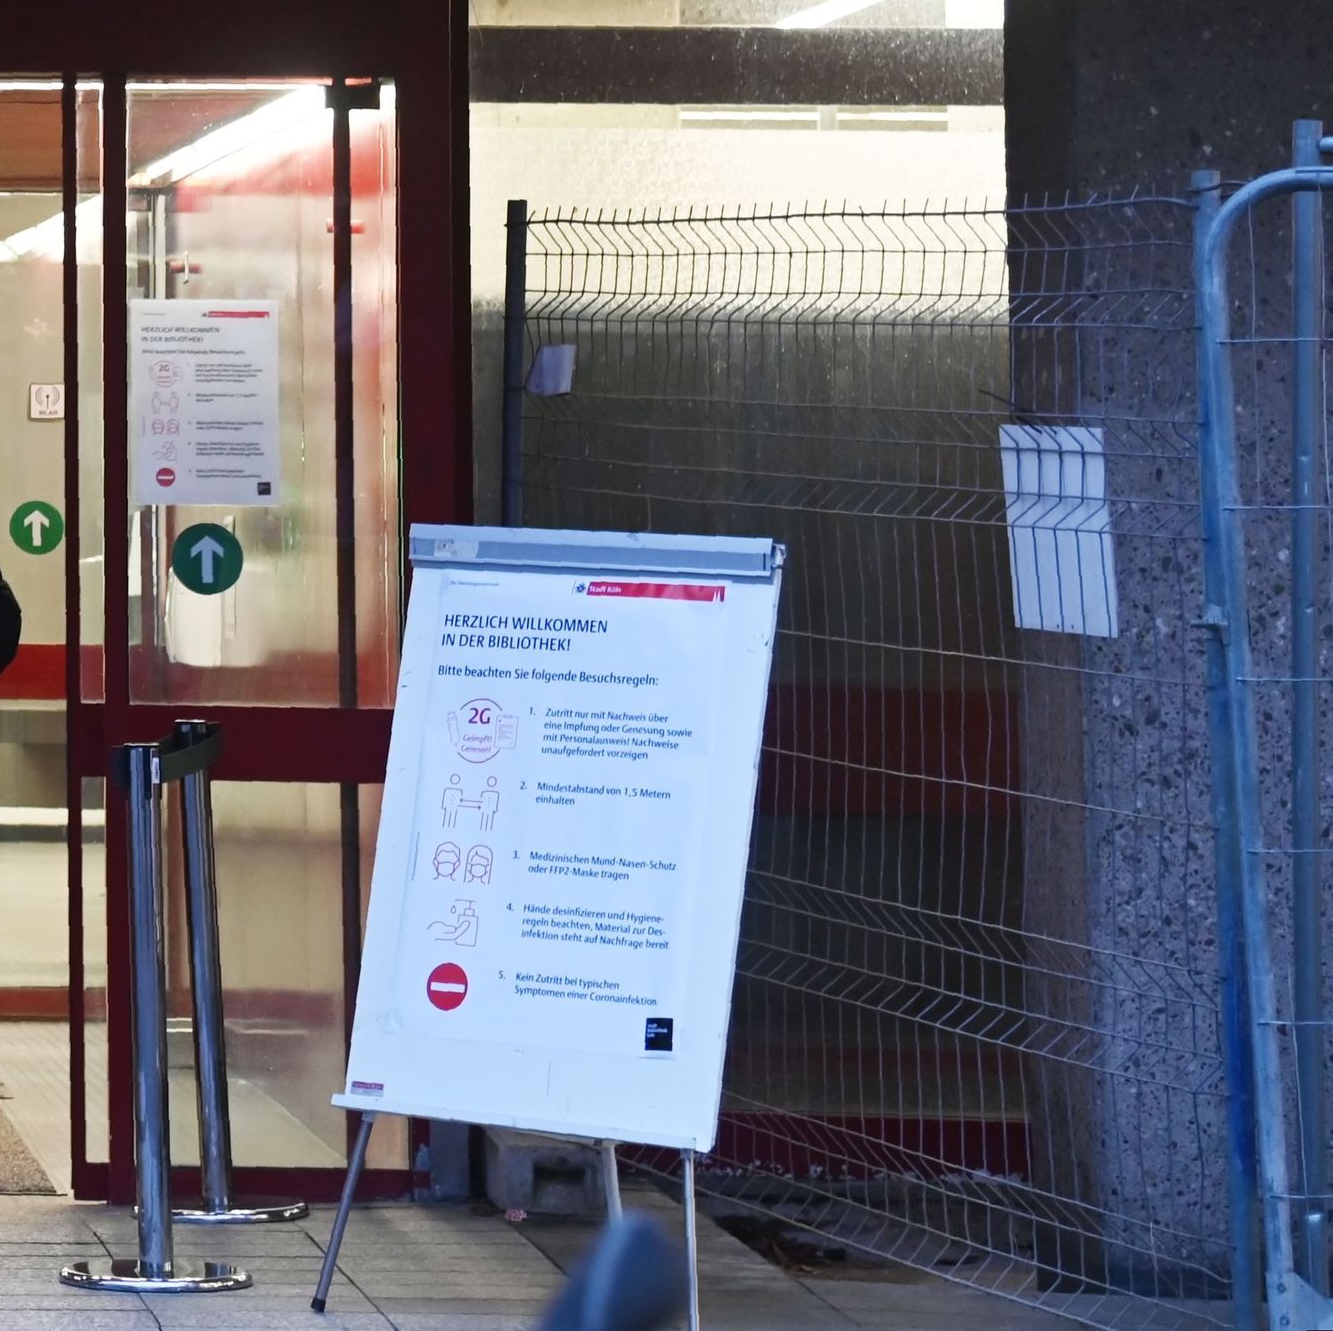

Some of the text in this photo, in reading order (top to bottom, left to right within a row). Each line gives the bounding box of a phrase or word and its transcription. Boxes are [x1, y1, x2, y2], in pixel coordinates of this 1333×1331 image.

[444, 614, 608, 634] HERZLICH WILLKOMMEN
[442, 633, 571, 652] IN DER BIBLIOTHEK!
[438, 665, 659, 688] Bitte beachten Sie folgende Besuchsregeln:
[468, 707, 492, 725] 2G
[529, 707, 669, 724] 1. Zutritt nur mit Nachweis über
[543, 721, 693, 738] eine Impfung oder Genesung sowie
[543, 733, 679, 750] mit Personalausweis! Nachweise
[541, 745, 648, 761] unaufgefordert vorzeigen
[519, 781, 528, 790] 2.
[537, 781, 605, 796] Mindestabstand
[606, 787, 621, 796] von
[639, 788, 671, 800] Metern
[535, 795, 576, 805] einhalten
[512, 850, 677, 871] 3. Medizinischen Mund-Nasen-Schutz
[528, 864, 630, 882] oder FFP2-Maske tragen
[506, 902, 665, 925] 4. Hände desinfizieren und Hygiene-
[522, 917, 666, 937] regeln beachten, Material zur Des-
[521, 929, 669, 950] infektion steht auf Nachfrage bereit
[498, 970, 620, 990] 5. Kein Zutritt bei typischen
[514, 985, 657, 1006] Symptomen einer Coronainfektion
